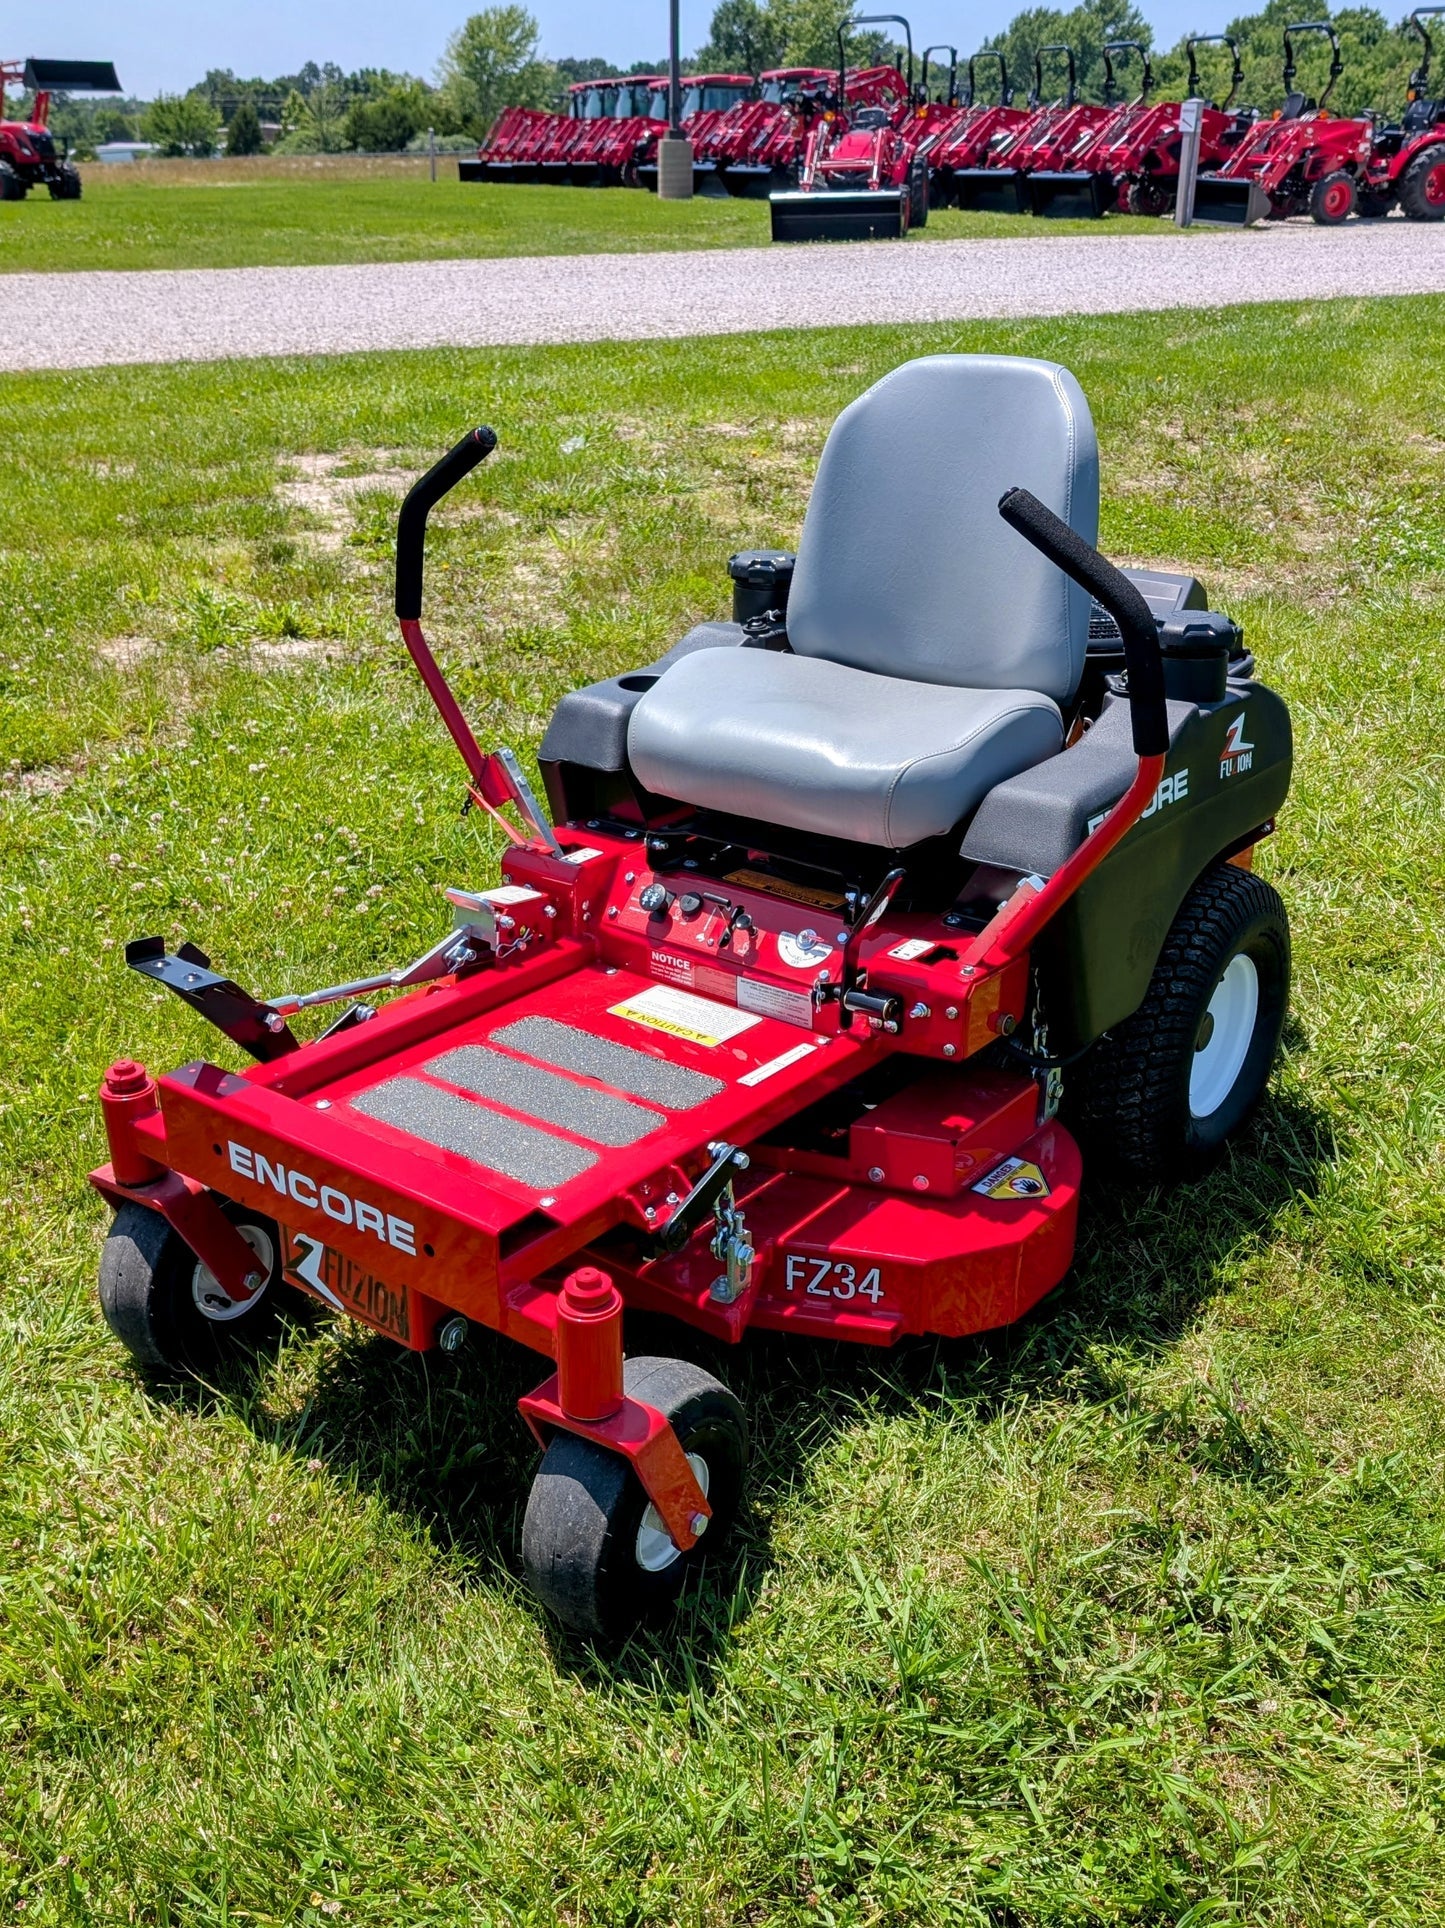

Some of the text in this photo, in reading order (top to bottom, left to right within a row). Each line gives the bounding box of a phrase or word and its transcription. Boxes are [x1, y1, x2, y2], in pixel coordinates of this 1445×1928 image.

[1220, 751, 1253, 780] FUZION
[1087, 768, 1189, 836] ERE
[651, 950, 691, 971] NOTICE
[638, 1014, 693, 1036] CAUTION
[981, 1163, 1017, 1188] DANGER
[228, 1140, 417, 1257] ENCORE
[324, 1246, 411, 1342] FUZION
[786, 1254, 885, 1304] FZ34
